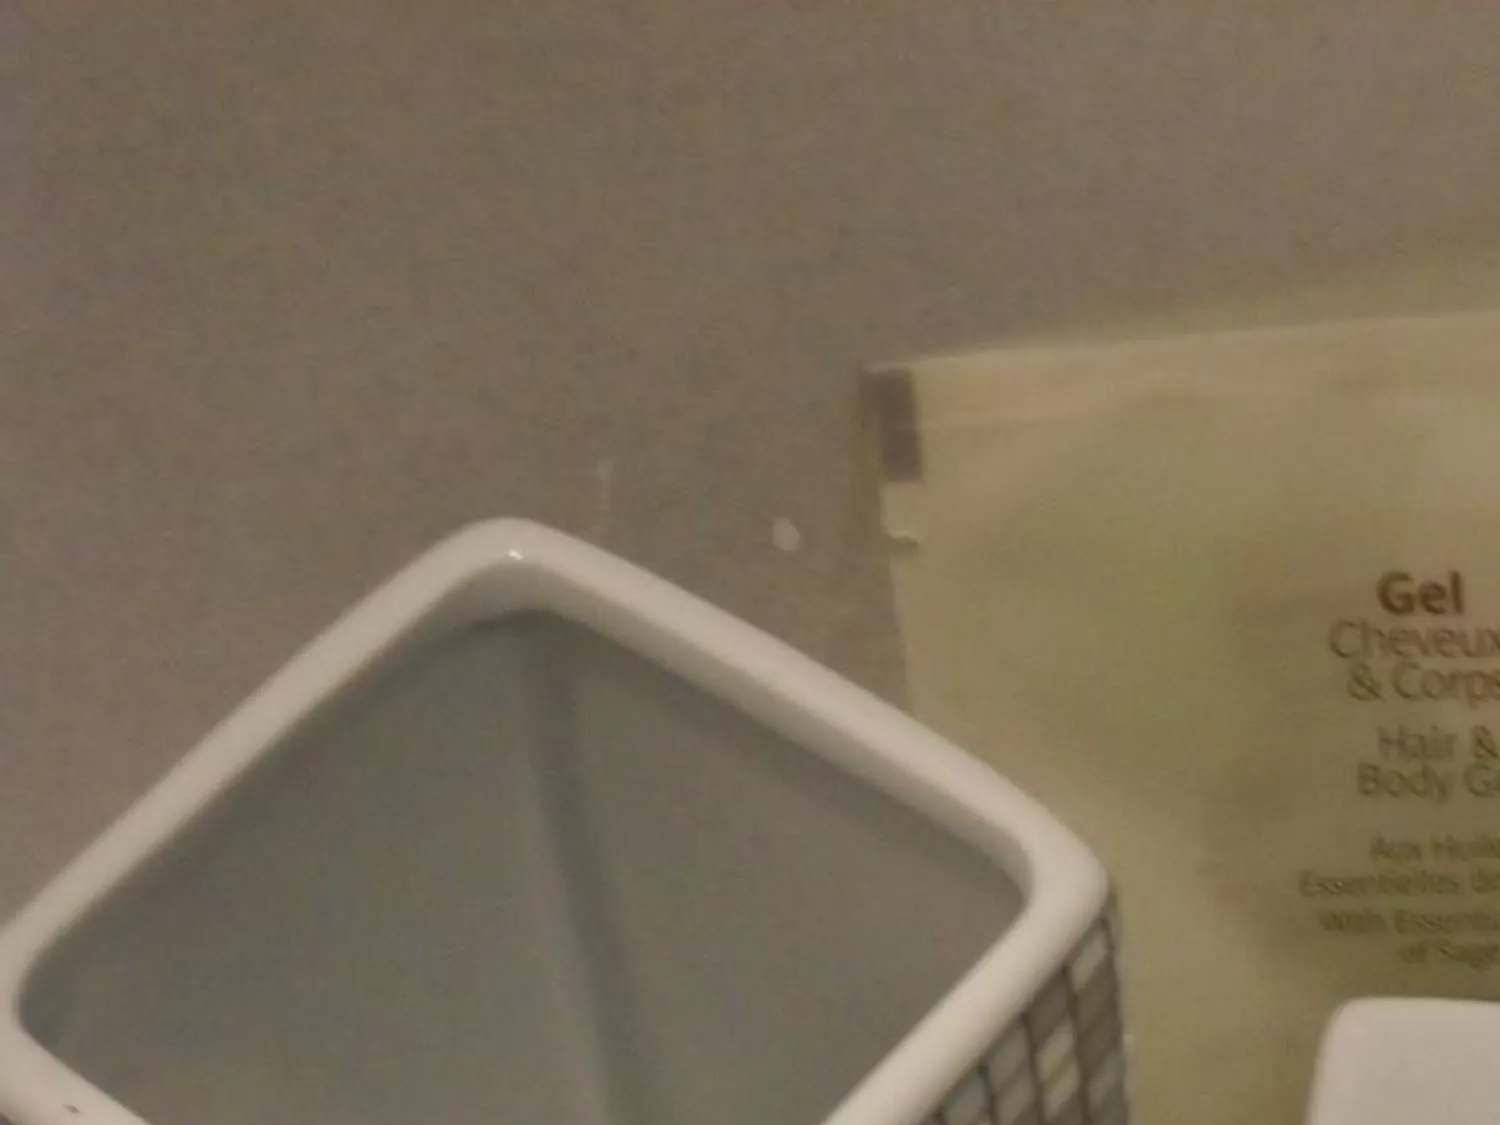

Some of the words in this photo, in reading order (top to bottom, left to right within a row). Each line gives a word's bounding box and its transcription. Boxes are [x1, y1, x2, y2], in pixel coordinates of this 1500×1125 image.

[1376, 570, 1465, 616] Gel
[1347, 662, 1384, 701] &
[1378, 725, 1457, 760] Hair
[1471, 725, 1500, 760] &
[1357, 762, 1447, 805] Body
